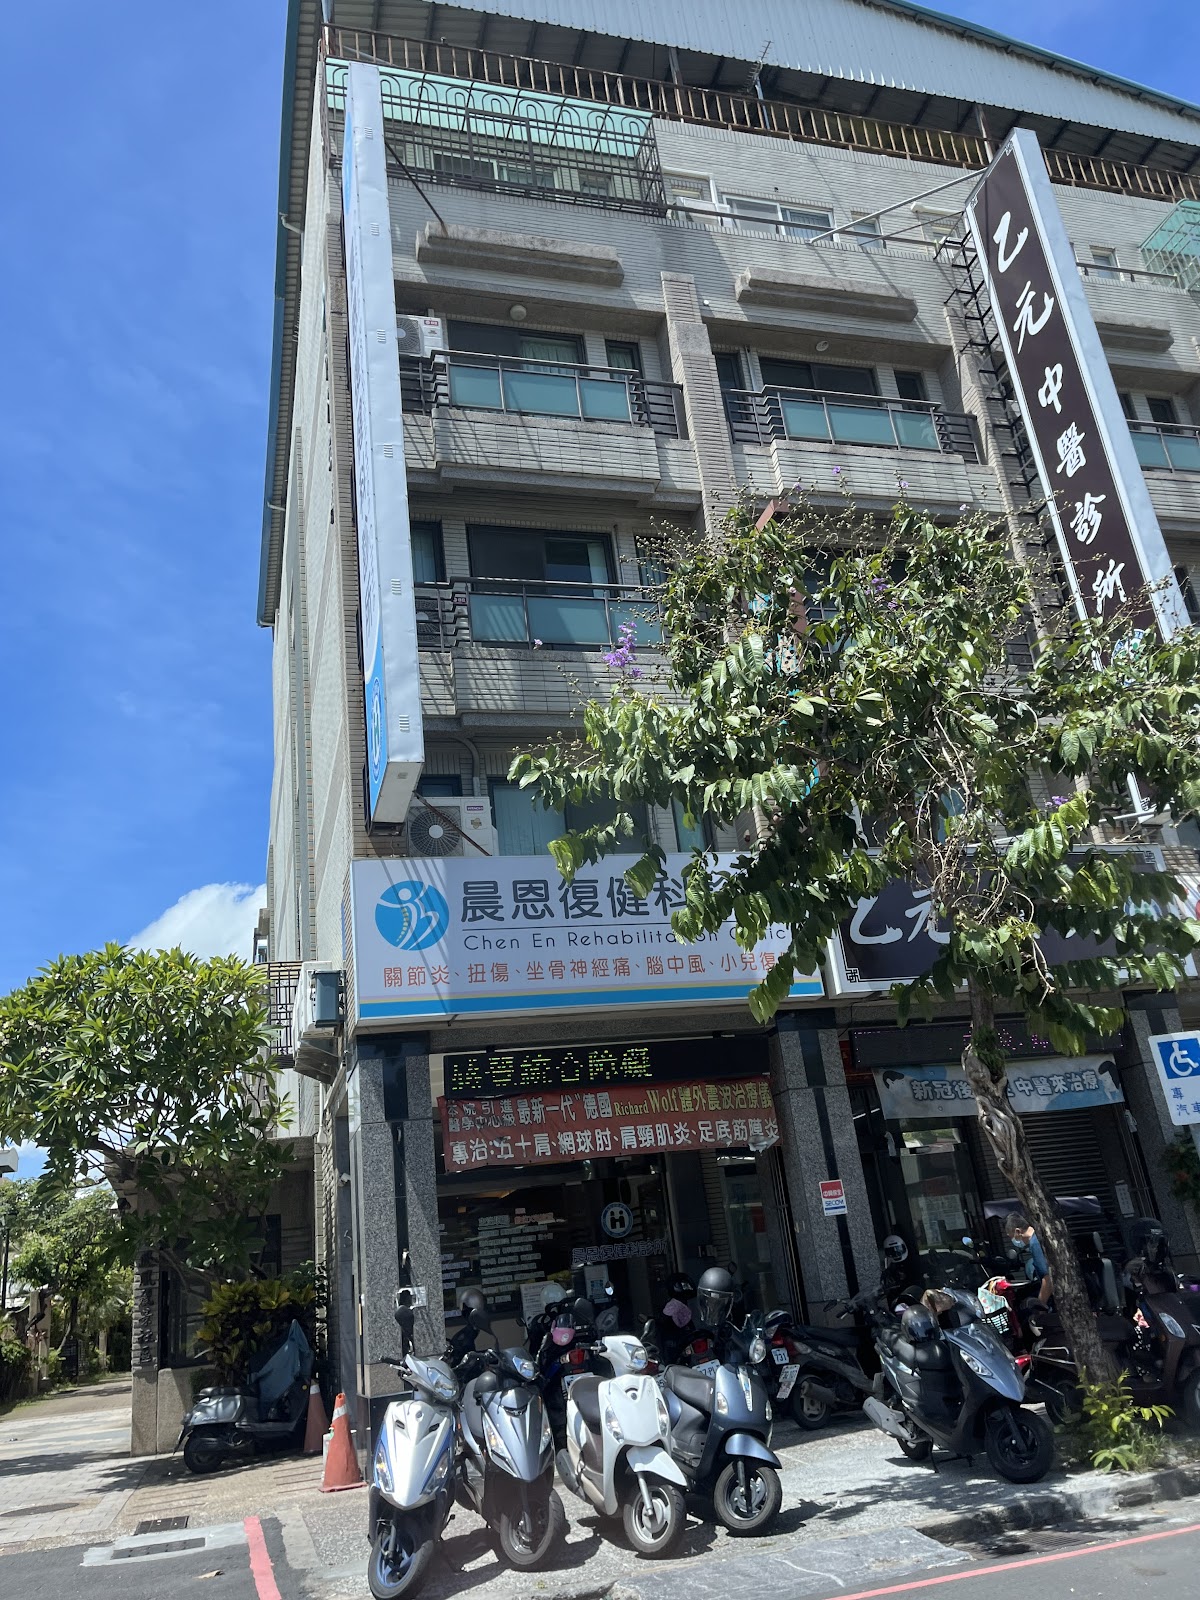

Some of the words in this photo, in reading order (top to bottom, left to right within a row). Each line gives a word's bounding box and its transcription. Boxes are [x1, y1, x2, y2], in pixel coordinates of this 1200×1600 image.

[992, 210, 1128, 614] 乙元中醫診所
[460, 876, 728, 923] 晨恩復健科
[463, 935, 520, 950] Chen
[532, 933, 555, 948] En
[567, 926, 719, 947] Rehabilitaon
[383, 950, 790, 988] 關節炎、扭傷、坐骨神經痛、腦中風、小兒復
[615, 1100, 650, 1117] Richard
[647, 1088, 679, 1114] Wolf
[912, 1069, 1100, 1101] 新冠後中醫來治療
